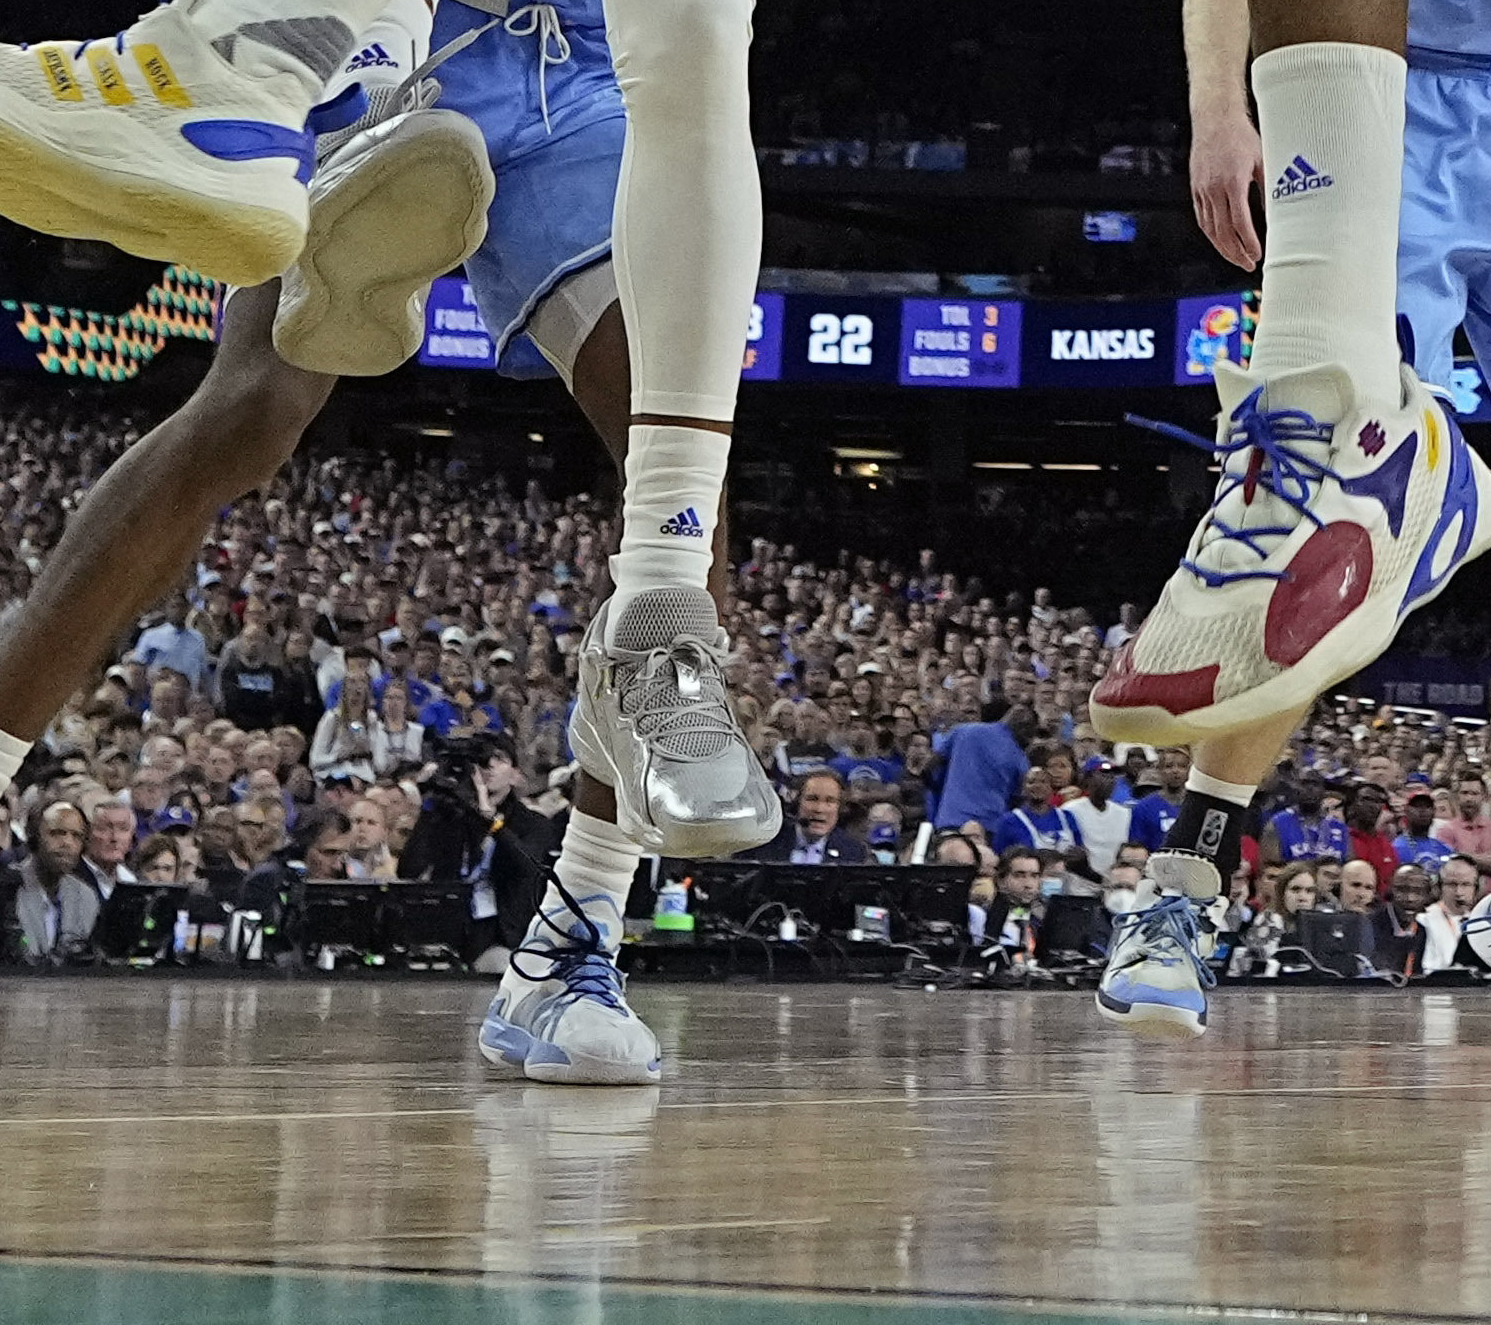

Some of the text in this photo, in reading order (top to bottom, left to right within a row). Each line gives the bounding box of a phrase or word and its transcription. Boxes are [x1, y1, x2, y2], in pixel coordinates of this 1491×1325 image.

[1271, 172, 1334, 200] adidas
[809, 314, 873, 365] 22
[914, 330, 970, 353] FOULS
[1051, 329, 1155, 360] KANSAS
[660, 522, 703, 538] adidas
